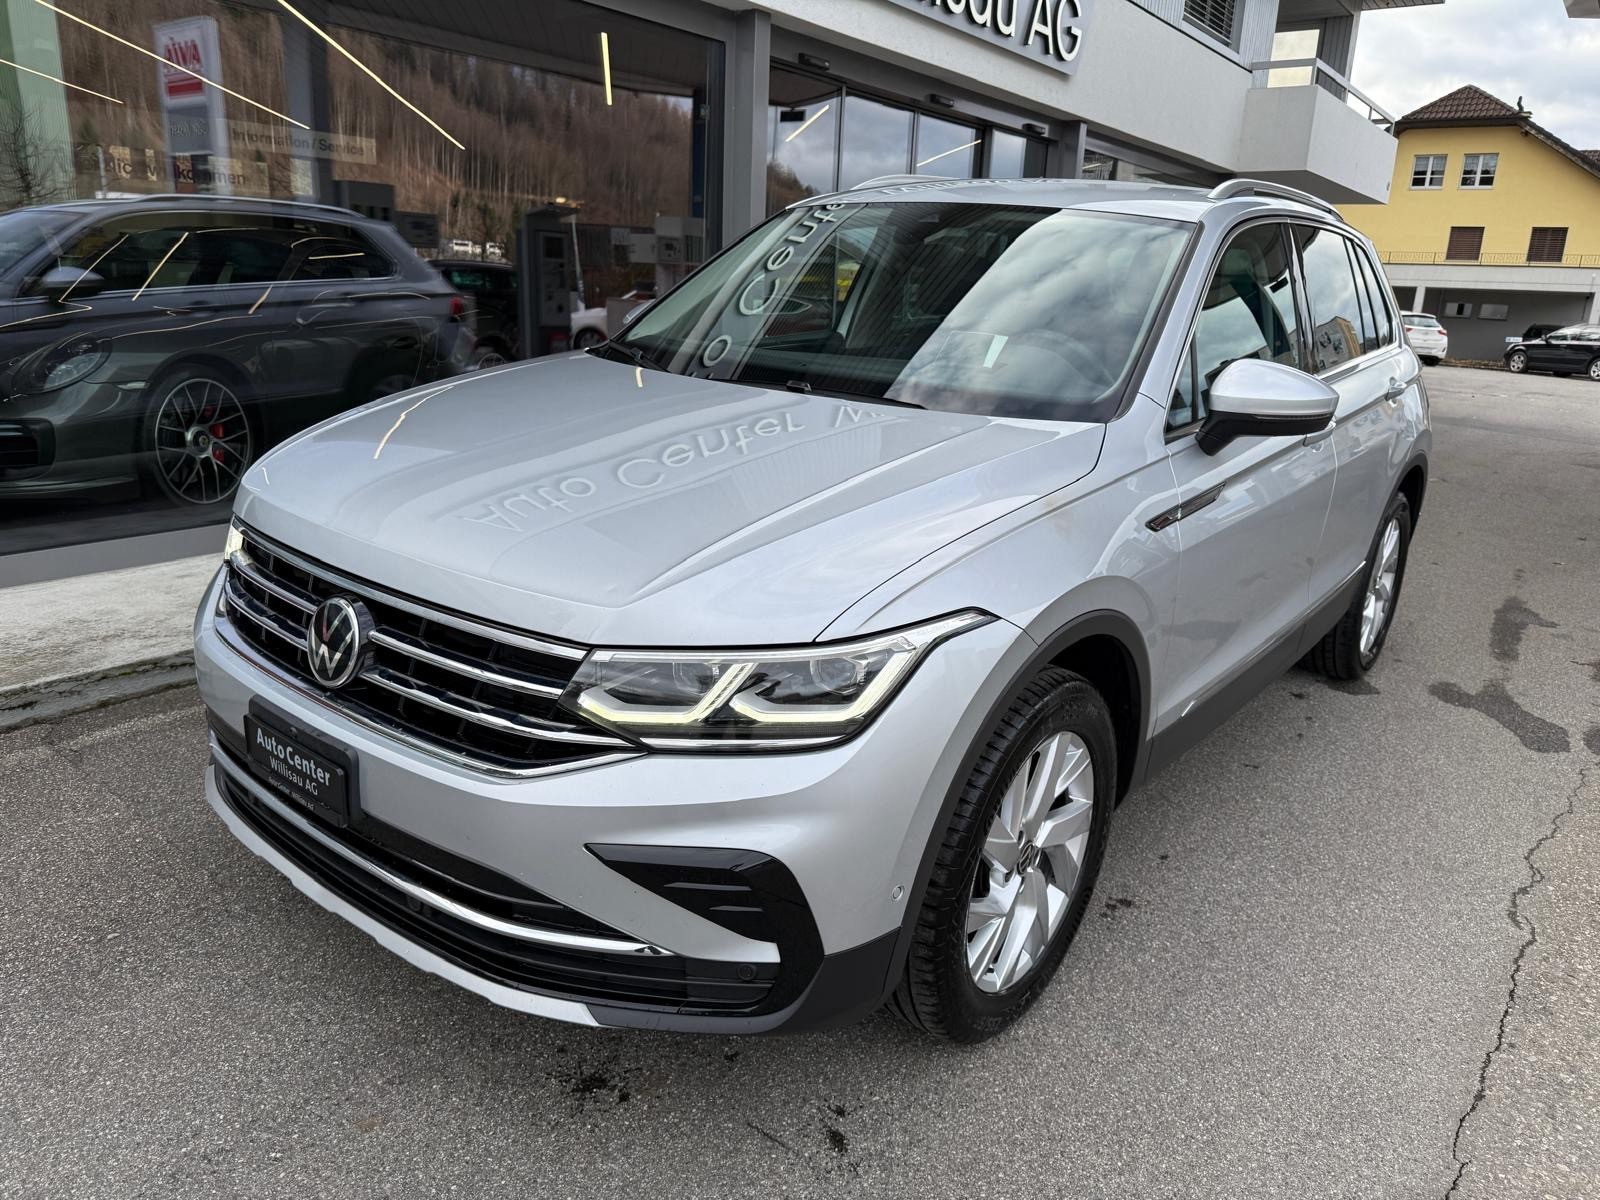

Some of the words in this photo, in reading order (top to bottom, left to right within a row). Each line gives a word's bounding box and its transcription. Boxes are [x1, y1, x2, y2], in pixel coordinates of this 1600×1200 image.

[1024, 0, 1082, 62] AG
[269, 755, 304, 787] Willisau
[304, 778, 318, 796] AG
